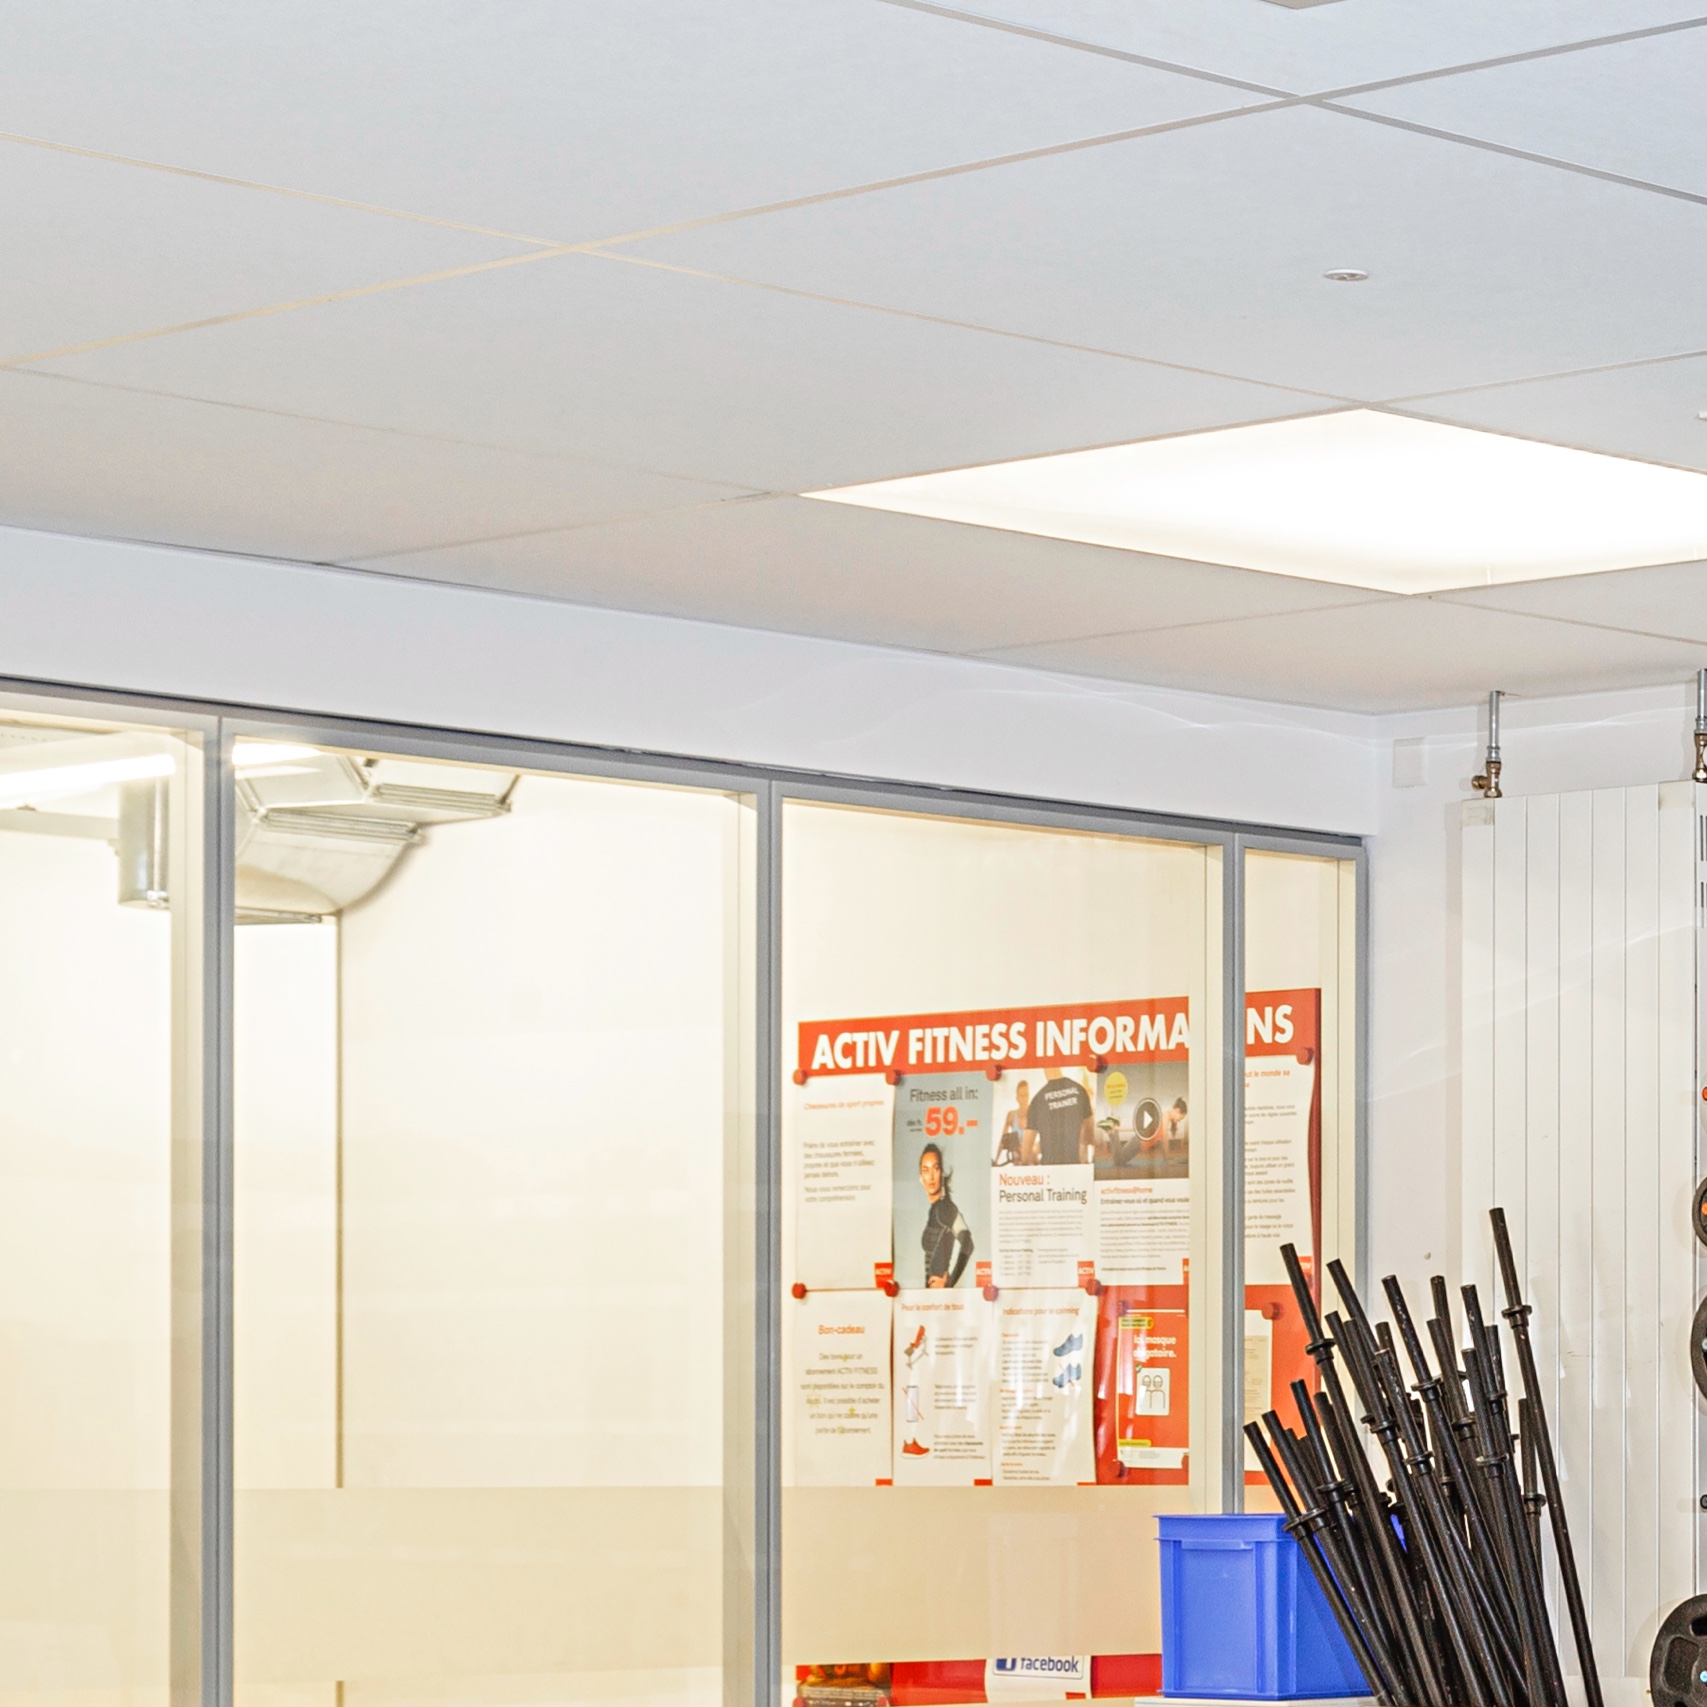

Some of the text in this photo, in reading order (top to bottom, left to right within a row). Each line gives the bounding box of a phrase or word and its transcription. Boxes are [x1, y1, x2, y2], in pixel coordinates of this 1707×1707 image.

[811, 1029, 900, 1070] ACTIV
[908, 1021, 1027, 1066] FITNESS
[910, 1088, 947, 1102] Fitness
[949, 1086, 963, 1101] all
[1044, 1086, 1080, 1101] PERSONAL
[1048, 1098, 1078, 1110] TRAINER
[924, 1106, 978, 1136] 59.-
[999, 1173, 1044, 1186] Nouveau
[999, 1188, 1088, 1204] Personal Training
[1020, 1656, 1079, 1674] facebook
